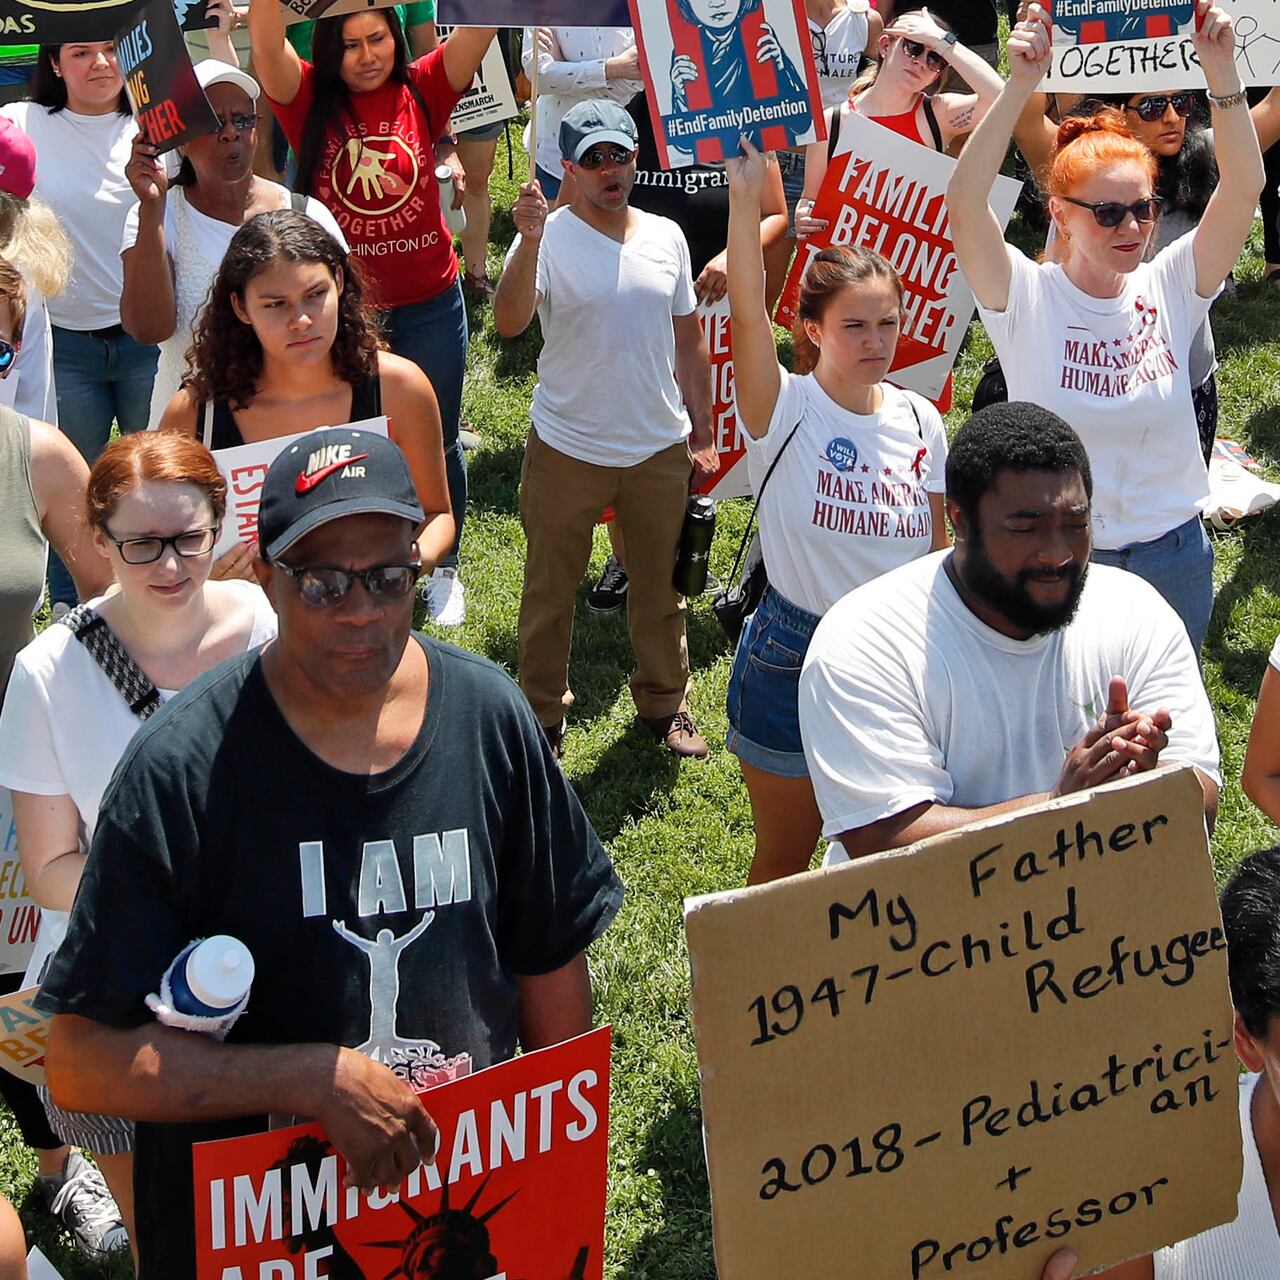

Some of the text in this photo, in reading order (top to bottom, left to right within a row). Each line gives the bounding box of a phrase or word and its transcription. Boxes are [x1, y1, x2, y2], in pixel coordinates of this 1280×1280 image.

[667, 96, 808, 132] #EndFamilyDetention
[306, 443, 353, 476] NIKE
[340, 464, 367, 480] AIR
[299, 827, 472, 918] I AM
[828, 814, 1169, 952] My Father
[1024, 925, 1227, 1014] Refugee
[1149, 1074, 1220, 1115] an
[910, 1176, 1169, 1280] Professor
